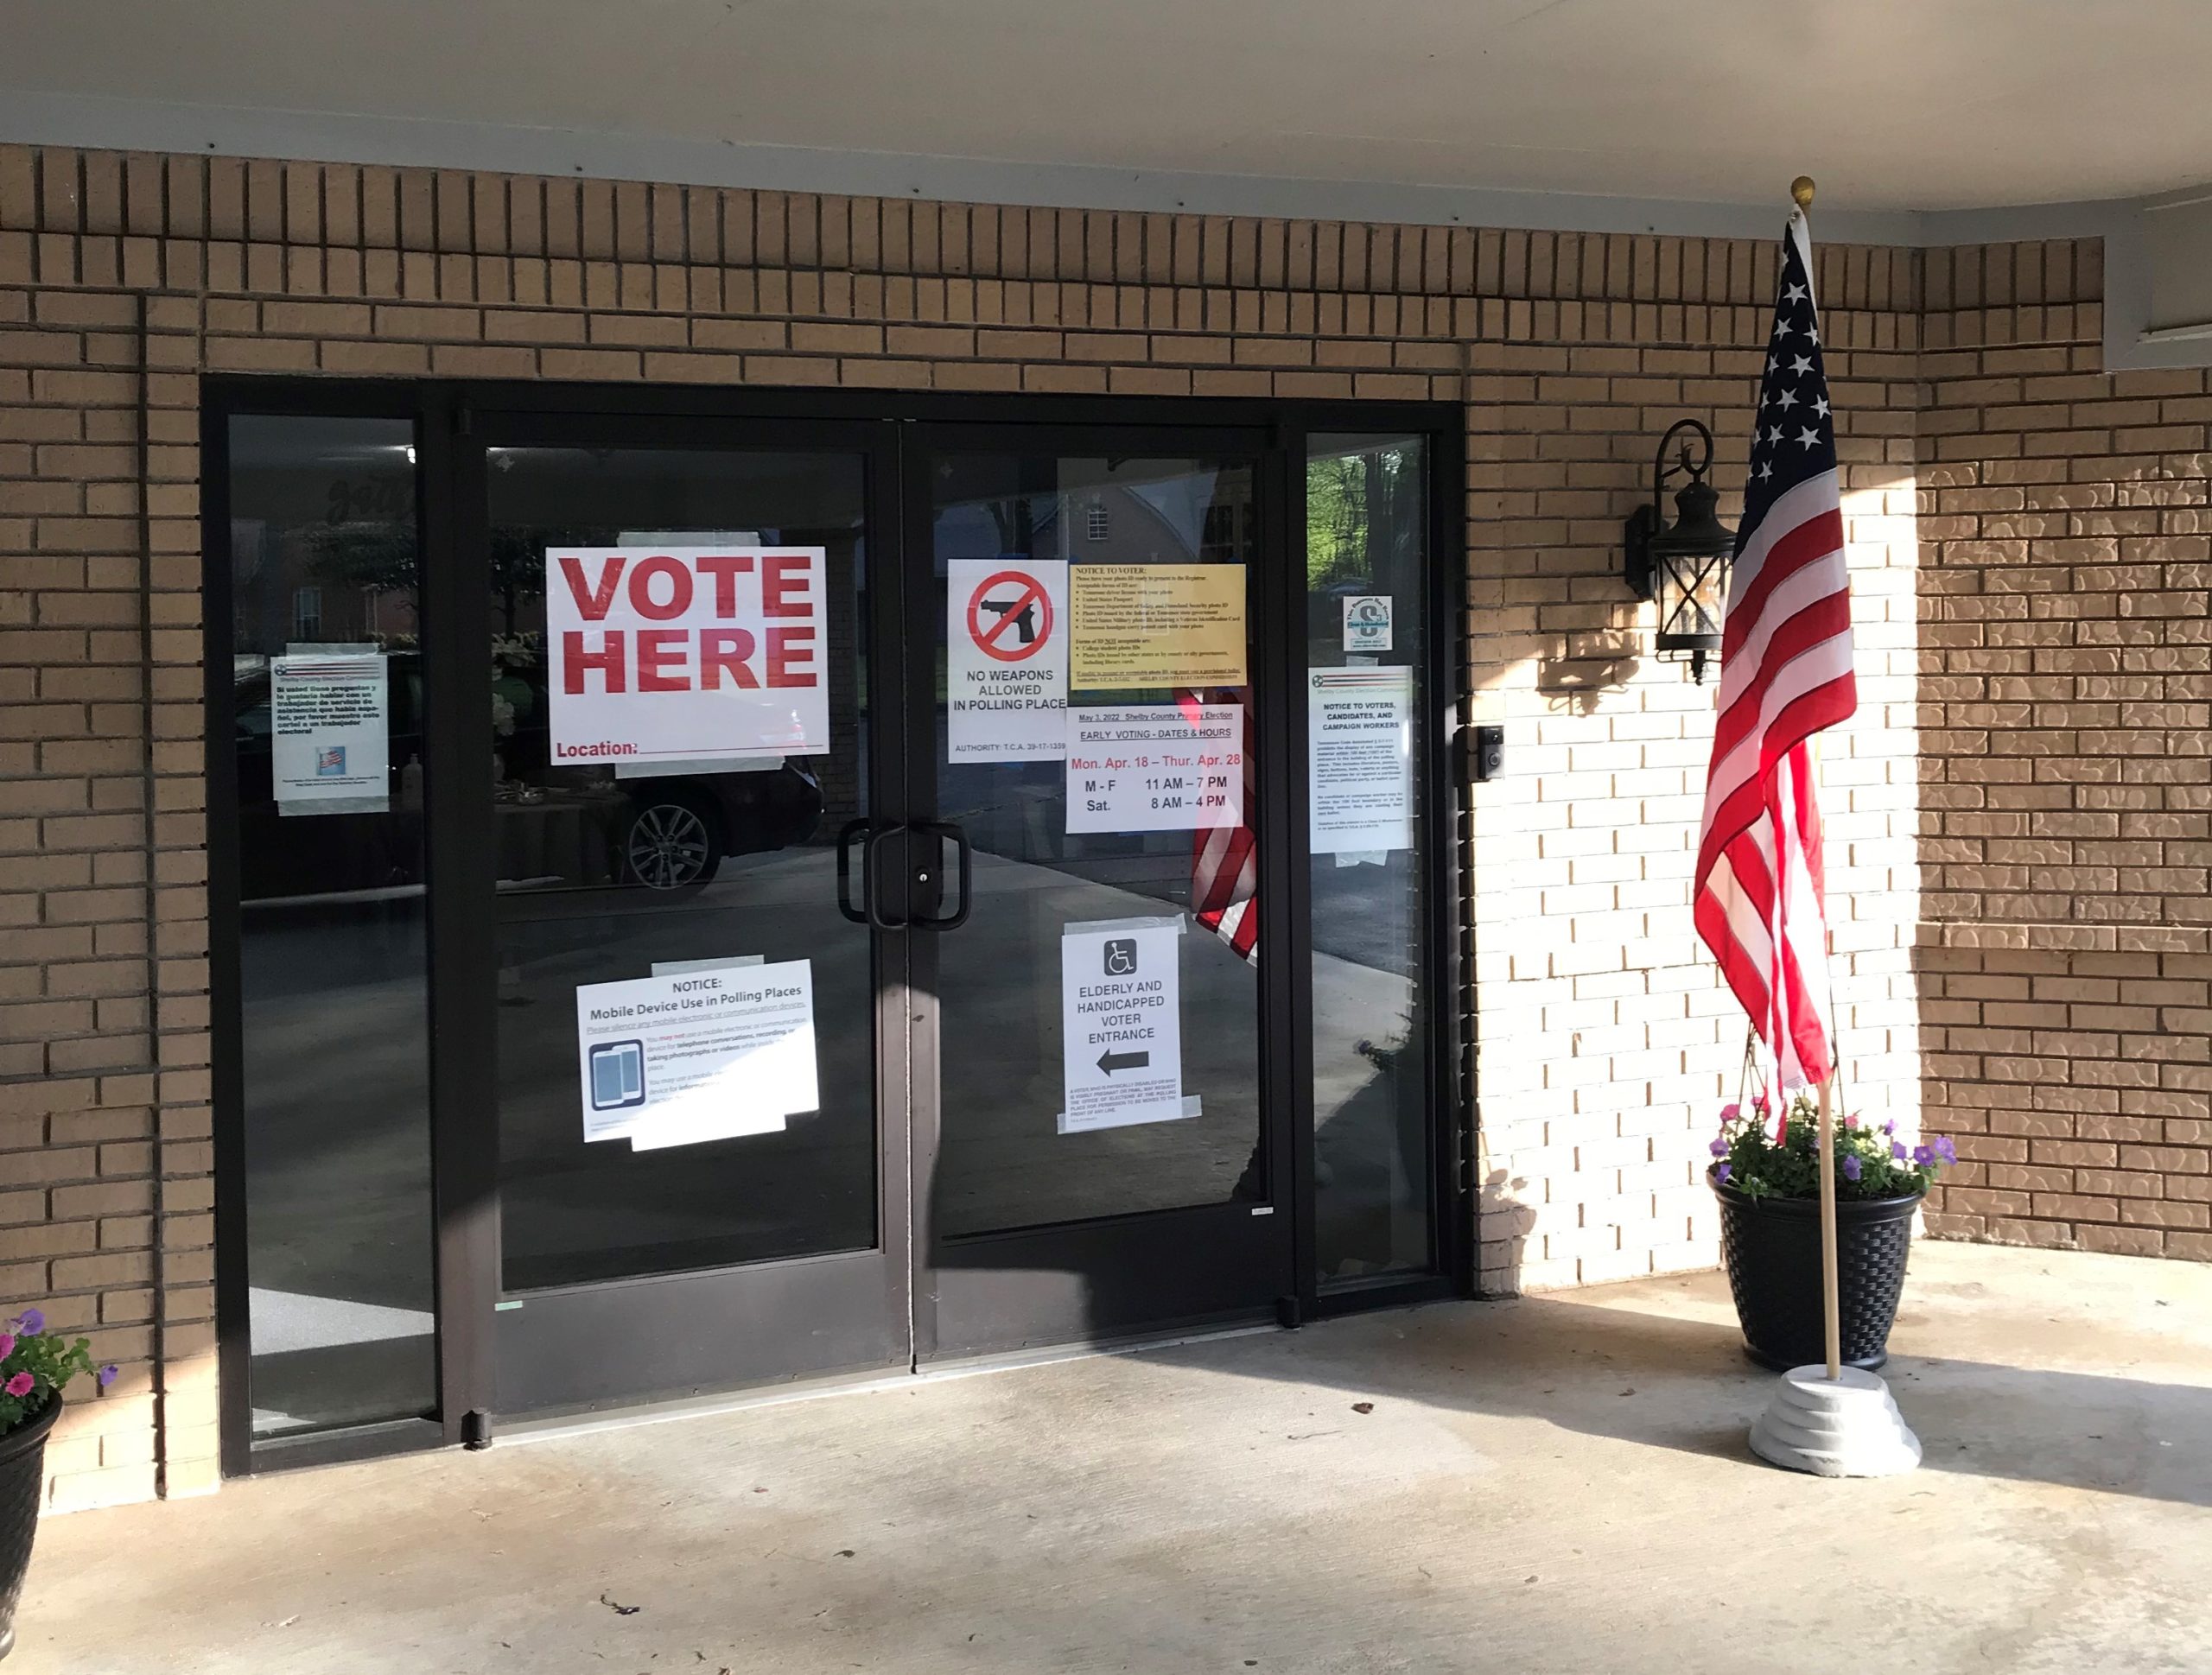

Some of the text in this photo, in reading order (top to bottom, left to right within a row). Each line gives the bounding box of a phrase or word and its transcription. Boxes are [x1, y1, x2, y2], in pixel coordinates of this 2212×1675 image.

[557, 555, 813, 621] VOTE
[563, 626, 817, 695] HERE
[967, 669, 1054, 681] NO WEAPONS
[979, 684, 1042, 695] ALLOWED
[954, 698, 1066, 711] IN POLLING PLACE
[1080, 731, 1111, 739] EARLY
[1116, 730, 1150, 739] VOTING
[1158, 729, 1188, 738] DATES
[1199, 728, 1231, 737] HOURS
[556, 740, 639, 758] Location:
[1071, 758, 1102, 770] Mon.
[1104, 758, 1131, 771] Apr.
[1135, 757, 1148, 767] 18
[1162, 755, 1193, 766] Thur.
[1197, 754, 1223, 767] Apr.
[1226, 754, 1241, 765] 28
[1085, 780, 1096, 791] M
[1108, 780, 1116, 791] F
[1146, 778, 1159, 790] 11
[1163, 777, 1183, 789] AM
[1197, 777, 1204, 788] 7
[1208, 777, 1227, 787] PM
[1086, 800, 1111, 811] Sat.
[1151, 797, 1159, 809] 8
[1162, 797, 1182, 809] AM
[1196, 796, 1203, 807] 4
[1206, 795, 1226, 806] PM
[672, 978, 722, 993] NOTICE:
[1079, 980, 1162, 998] ELDERLY AND
[590, 987, 802, 1020] Mobile Device Use in Polling Places
[1077, 995, 1165, 1013] HANDICAPPED
[1101, 1013, 1141, 1027] VOTER
[1089, 1028, 1154, 1044] ENTRANCE
